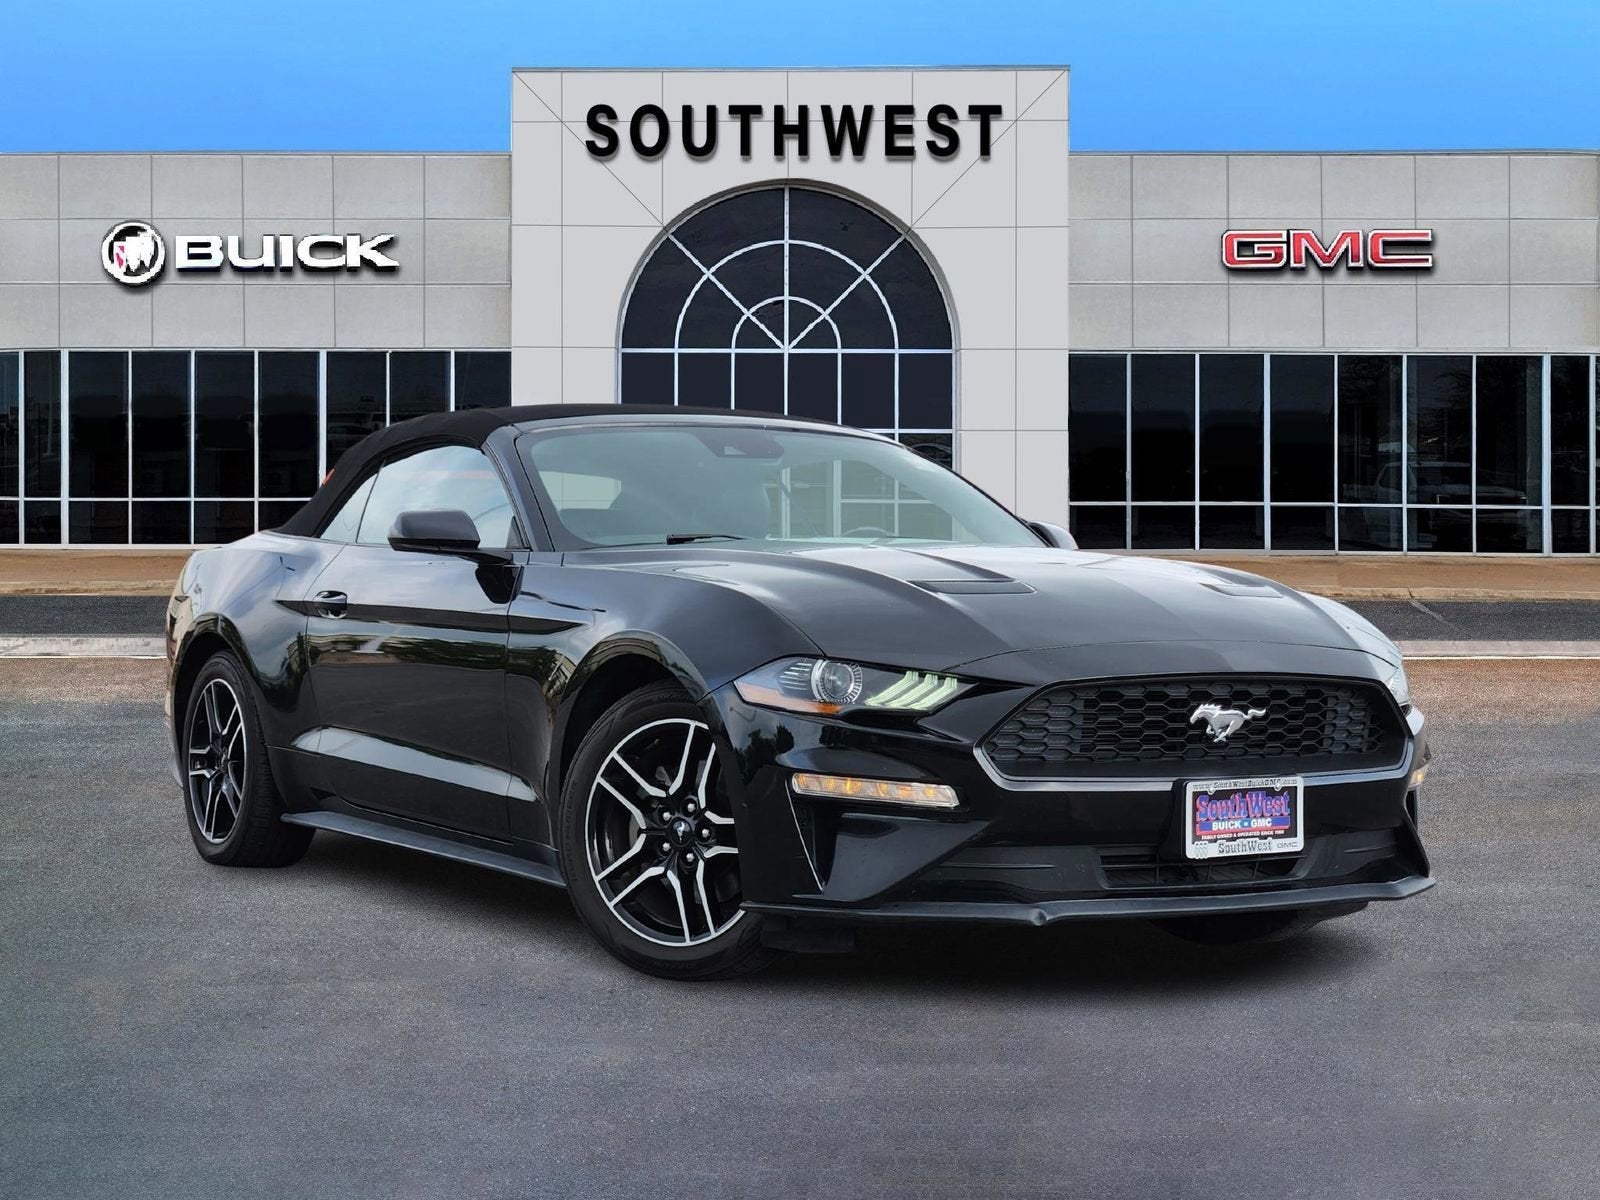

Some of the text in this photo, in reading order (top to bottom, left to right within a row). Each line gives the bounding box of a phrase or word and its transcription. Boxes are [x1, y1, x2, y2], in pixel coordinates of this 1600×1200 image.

[585, 104, 1003, 158] SOUTHWEST
[175, 234, 400, 271] BUICK
[1221, 229, 1433, 268] GMC
[1196, 790, 1290, 821] SouthWest
[1211, 818, 1272, 830] BUICK GMC
[1218, 840, 1273, 854] SouthWest
